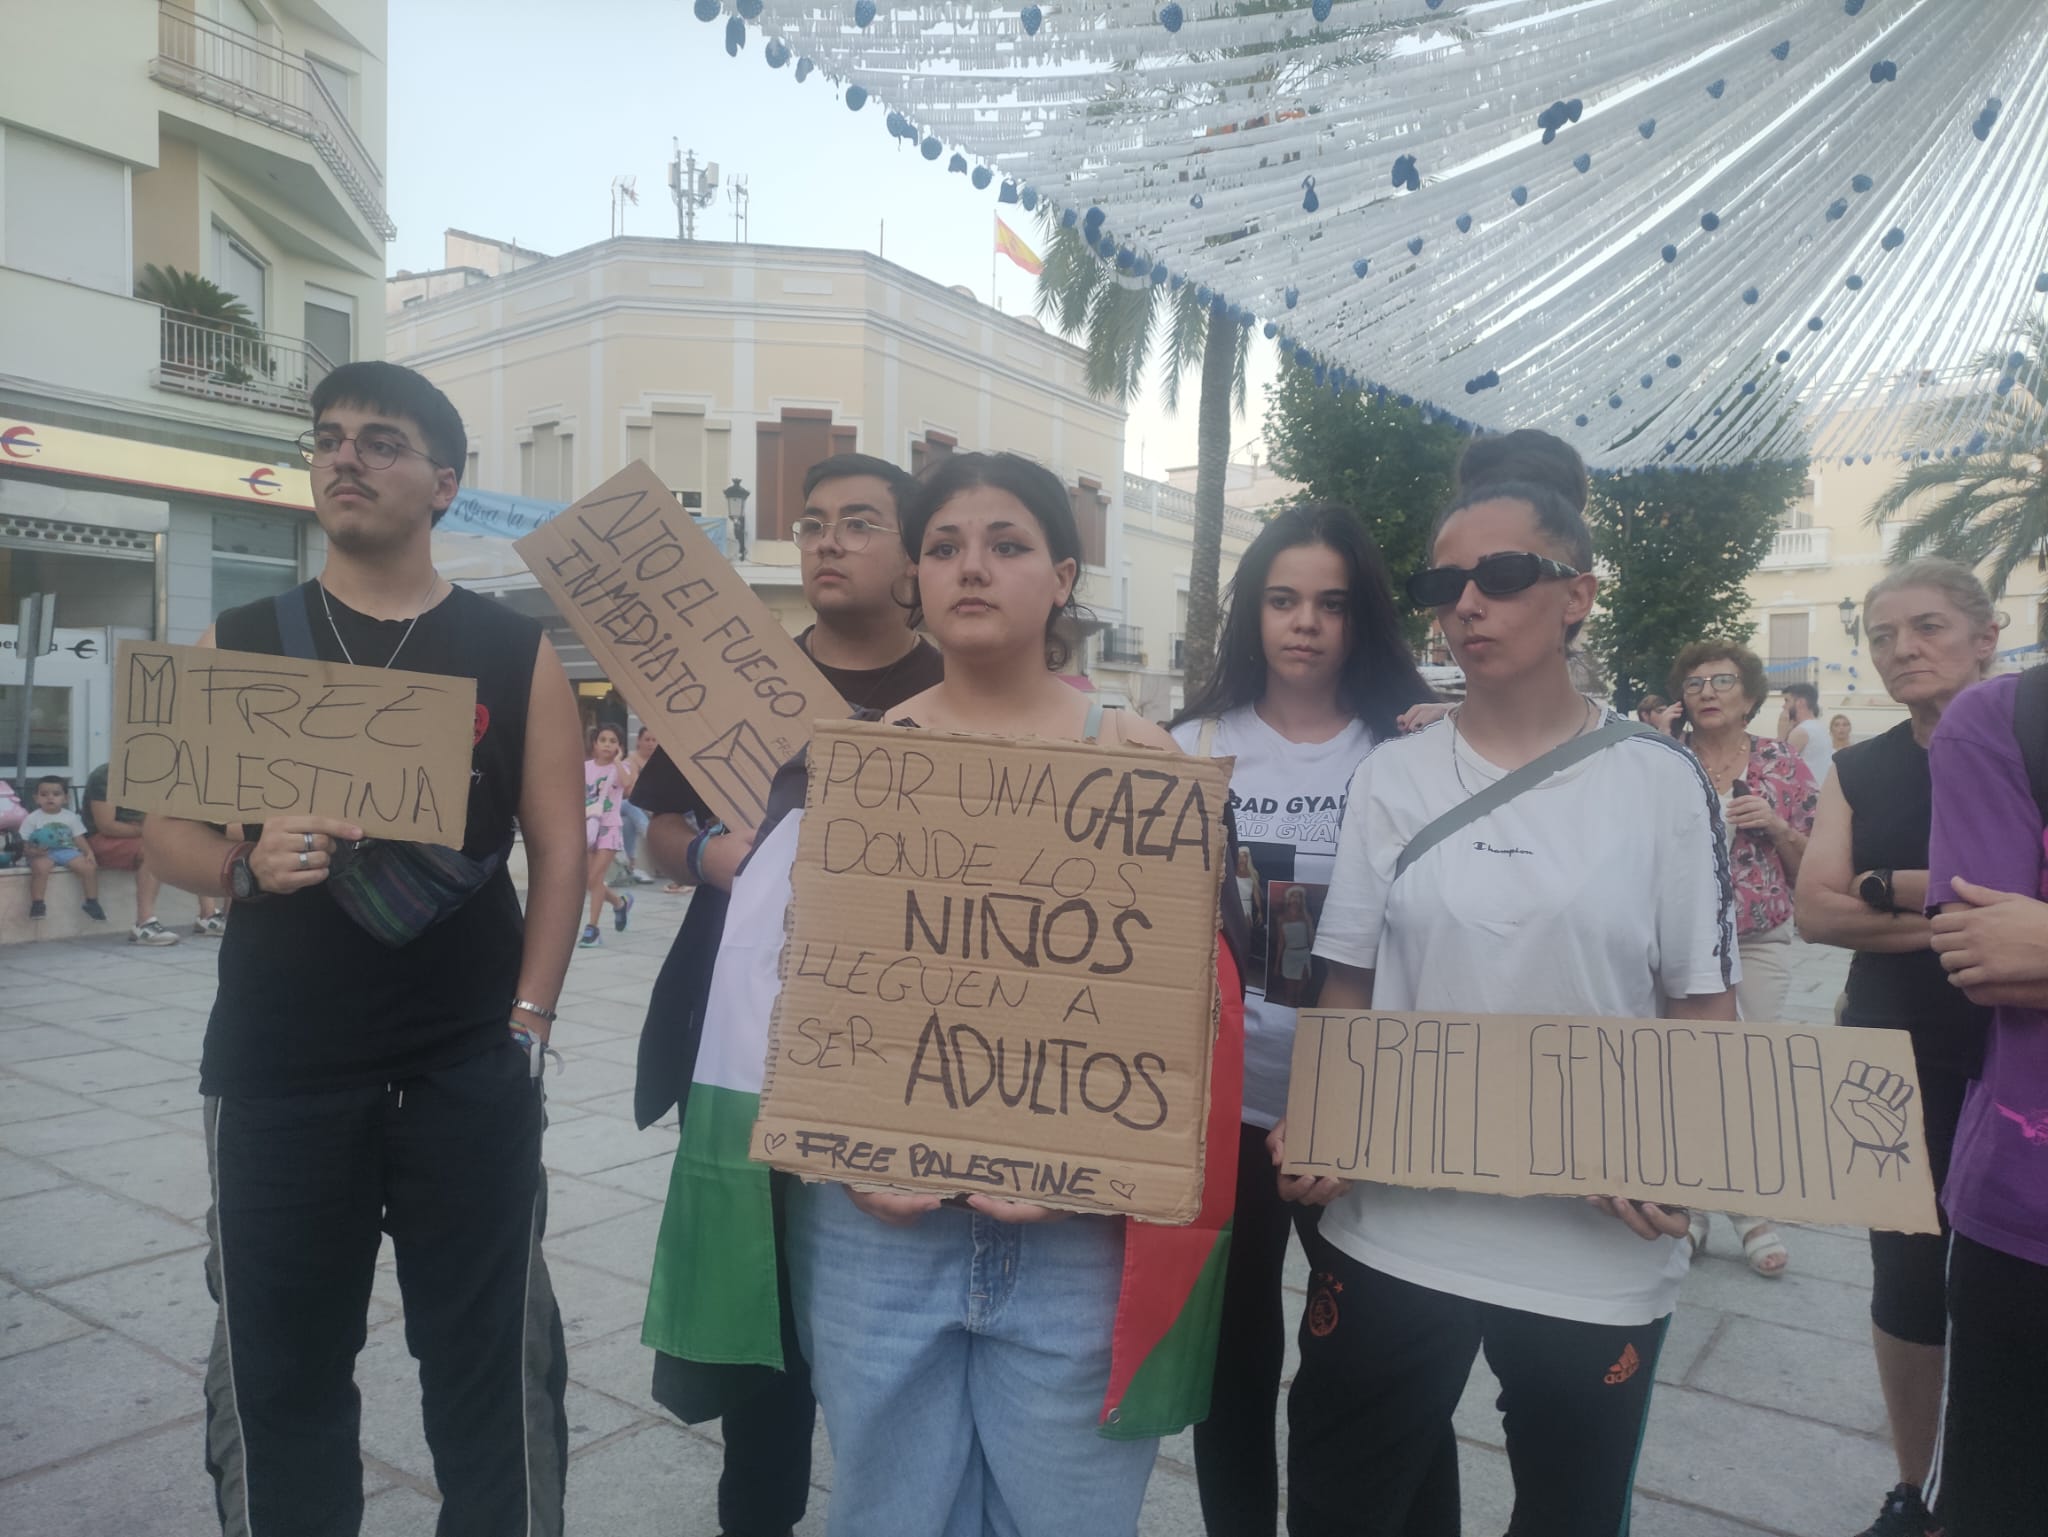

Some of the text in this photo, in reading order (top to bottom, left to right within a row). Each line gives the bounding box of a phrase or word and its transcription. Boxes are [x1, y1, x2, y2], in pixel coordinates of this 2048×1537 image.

[661, 577, 719, 628] EL
[702, 615, 807, 719] FUEGO
[188, 664, 448, 748] FREE
[123, 732, 443, 833] PALESTINA
[821, 740, 1211, 872] POR UNA GAZA
[822, 818, 1144, 910] DONDE LOS
[903, 889, 1153, 975] NIÑOS
[797, 943, 1101, 1025] LLEGUEN A
[787, 1007, 1169, 1131] SER ADULTOS
[1288, 1014, 1837, 1201] ISRAEL GENOCIDA
[796, 1130, 1102, 1197] FREE PALESTINE
